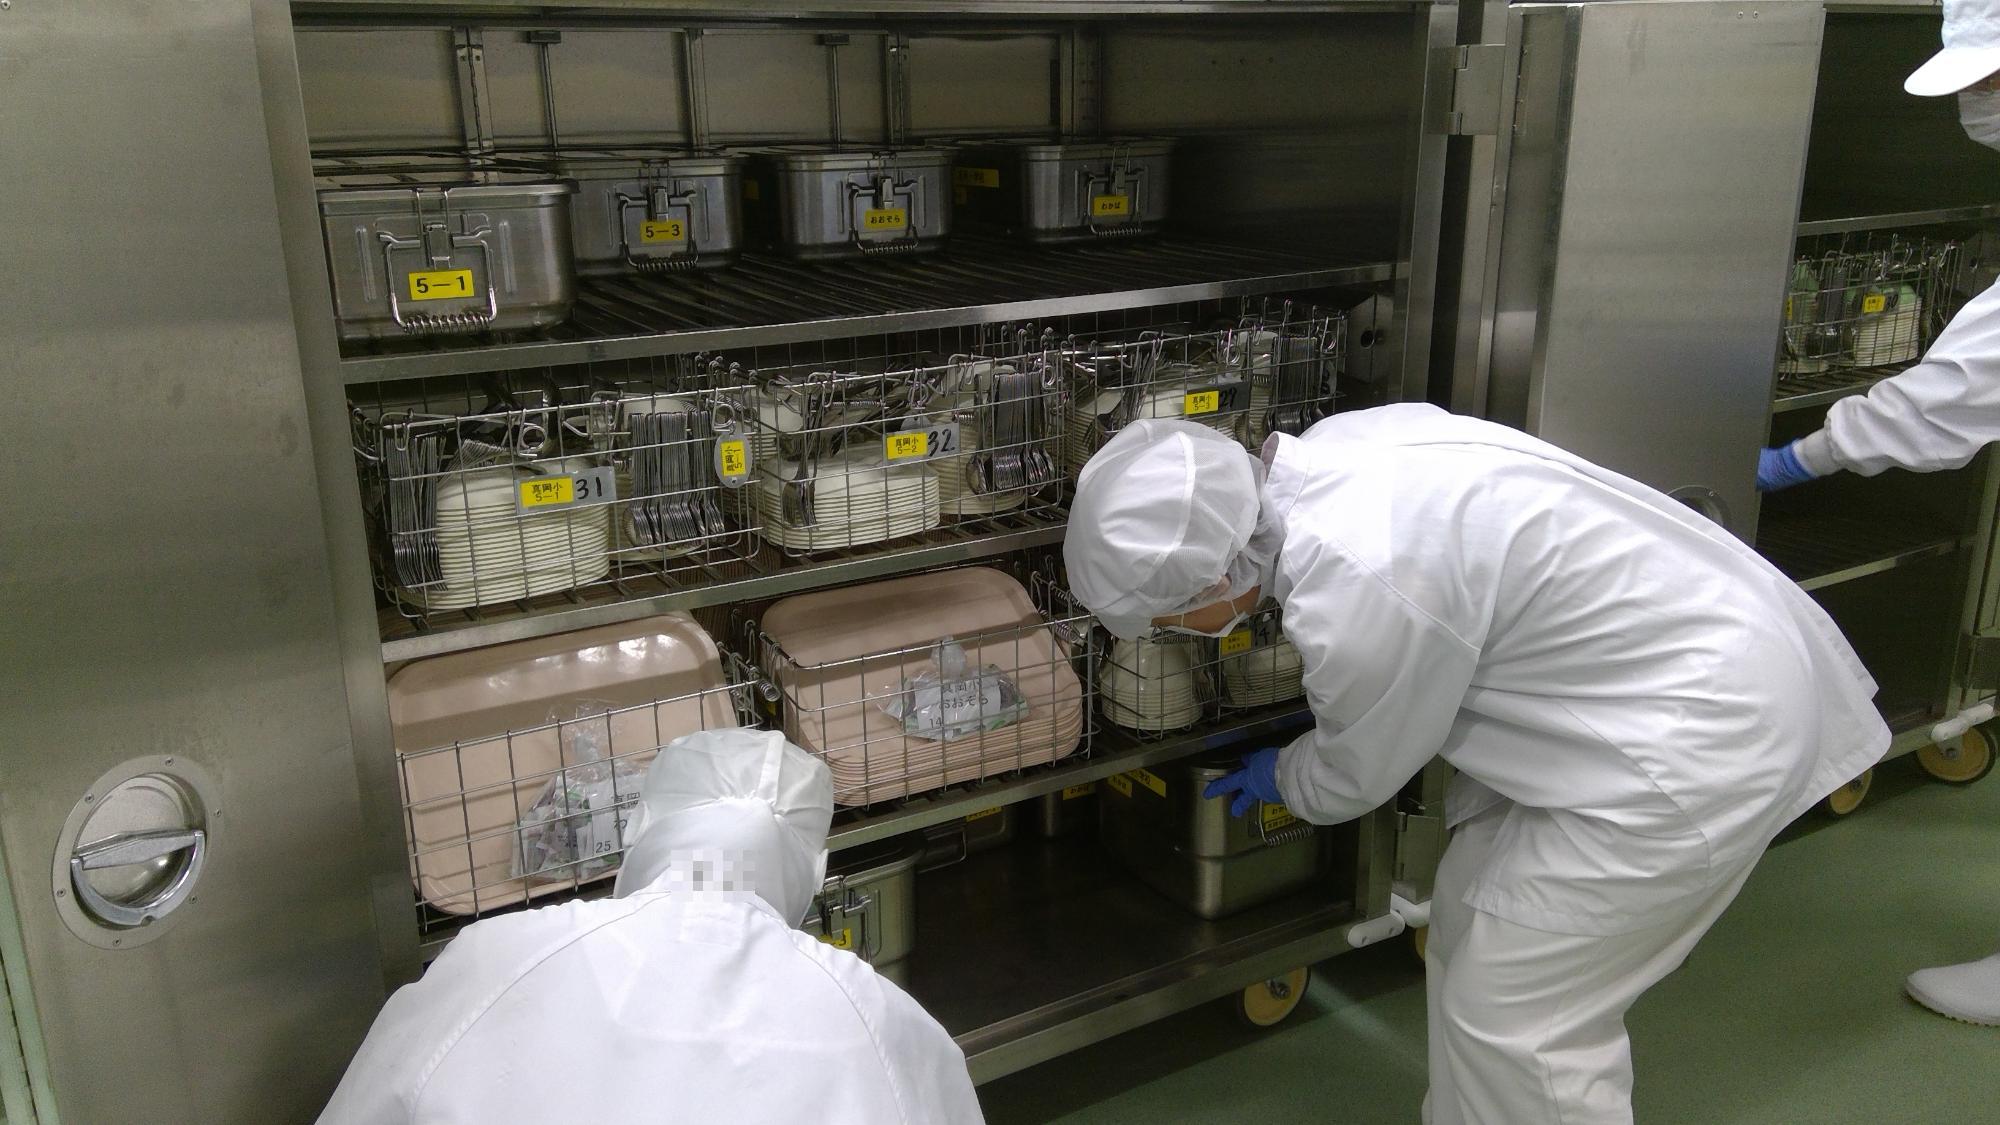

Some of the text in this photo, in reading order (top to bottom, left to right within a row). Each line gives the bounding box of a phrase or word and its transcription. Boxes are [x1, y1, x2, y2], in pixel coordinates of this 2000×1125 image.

[928, 428, 955, 457] 32
[576, 476, 602, 499] 31
[596, 840, 611, 853] 25
